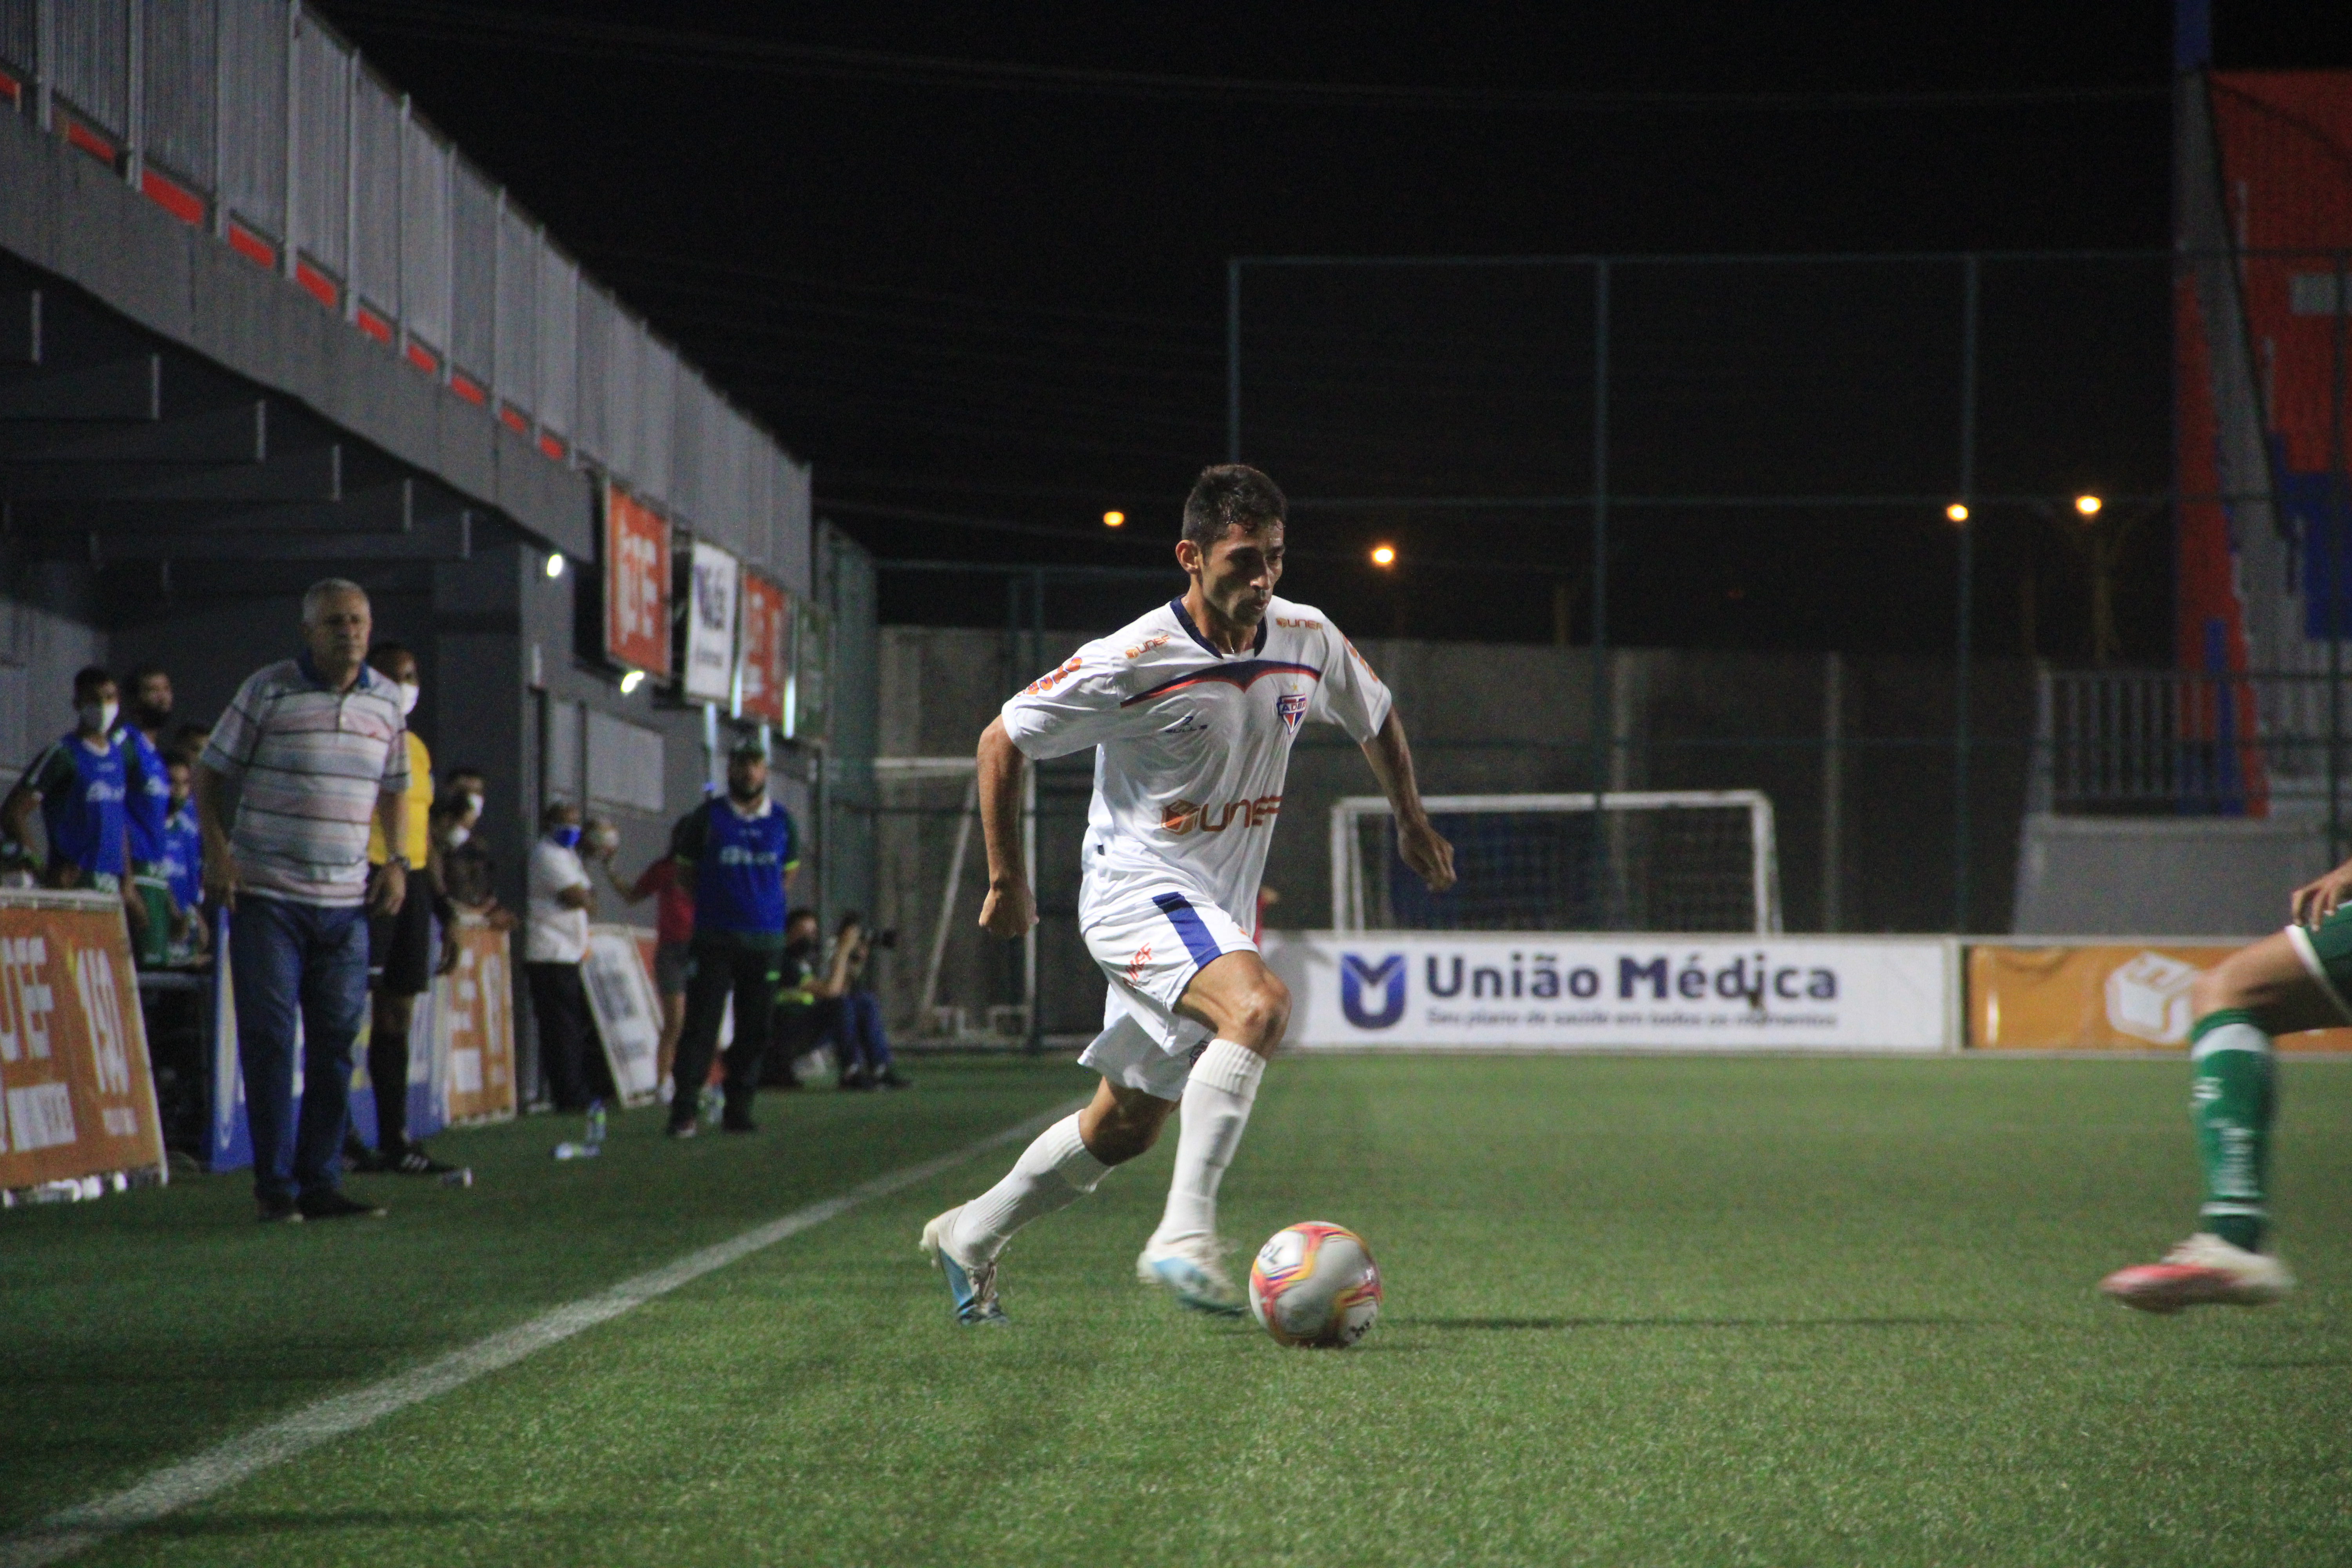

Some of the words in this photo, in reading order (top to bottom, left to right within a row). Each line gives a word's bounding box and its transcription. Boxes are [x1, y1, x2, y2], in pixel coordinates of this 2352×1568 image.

[1136, 635, 1170, 653] UNEF
[1426, 953, 1599, 999] União
[1618, 953, 1838, 1000] Médica
